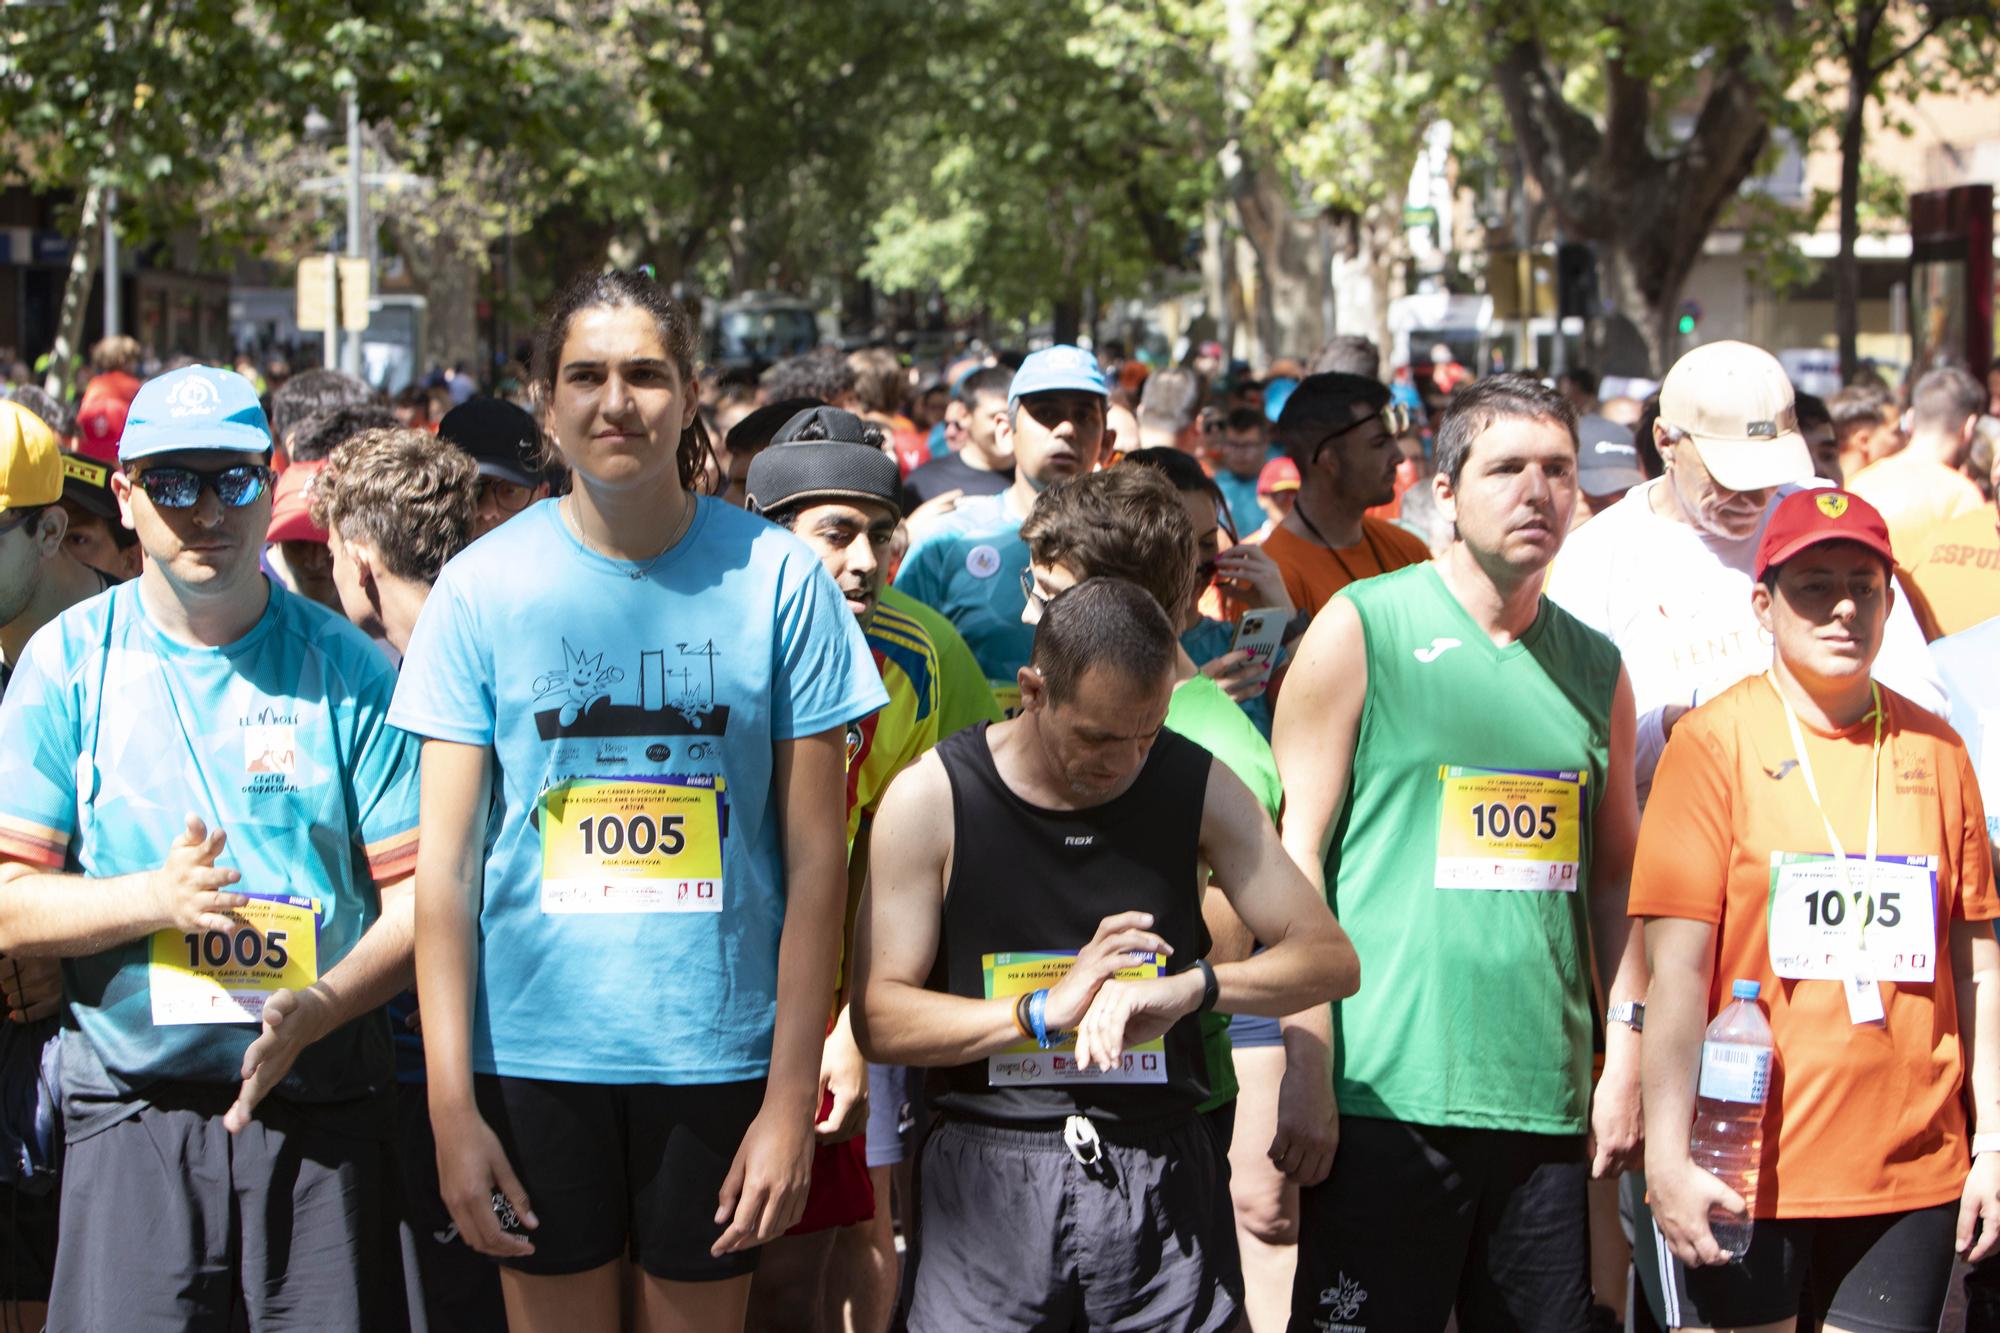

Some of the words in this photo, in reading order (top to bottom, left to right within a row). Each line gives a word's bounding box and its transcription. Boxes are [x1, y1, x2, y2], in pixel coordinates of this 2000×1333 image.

[241, 785, 300, 795] OCUPACIONAL
[254, 775, 286, 785] CENTRE
[687, 776, 713, 787] AVANÇAT
[1472, 803, 1557, 840] 1005
[579, 815, 686, 855] 1005
[184, 928, 289, 969] 1005
